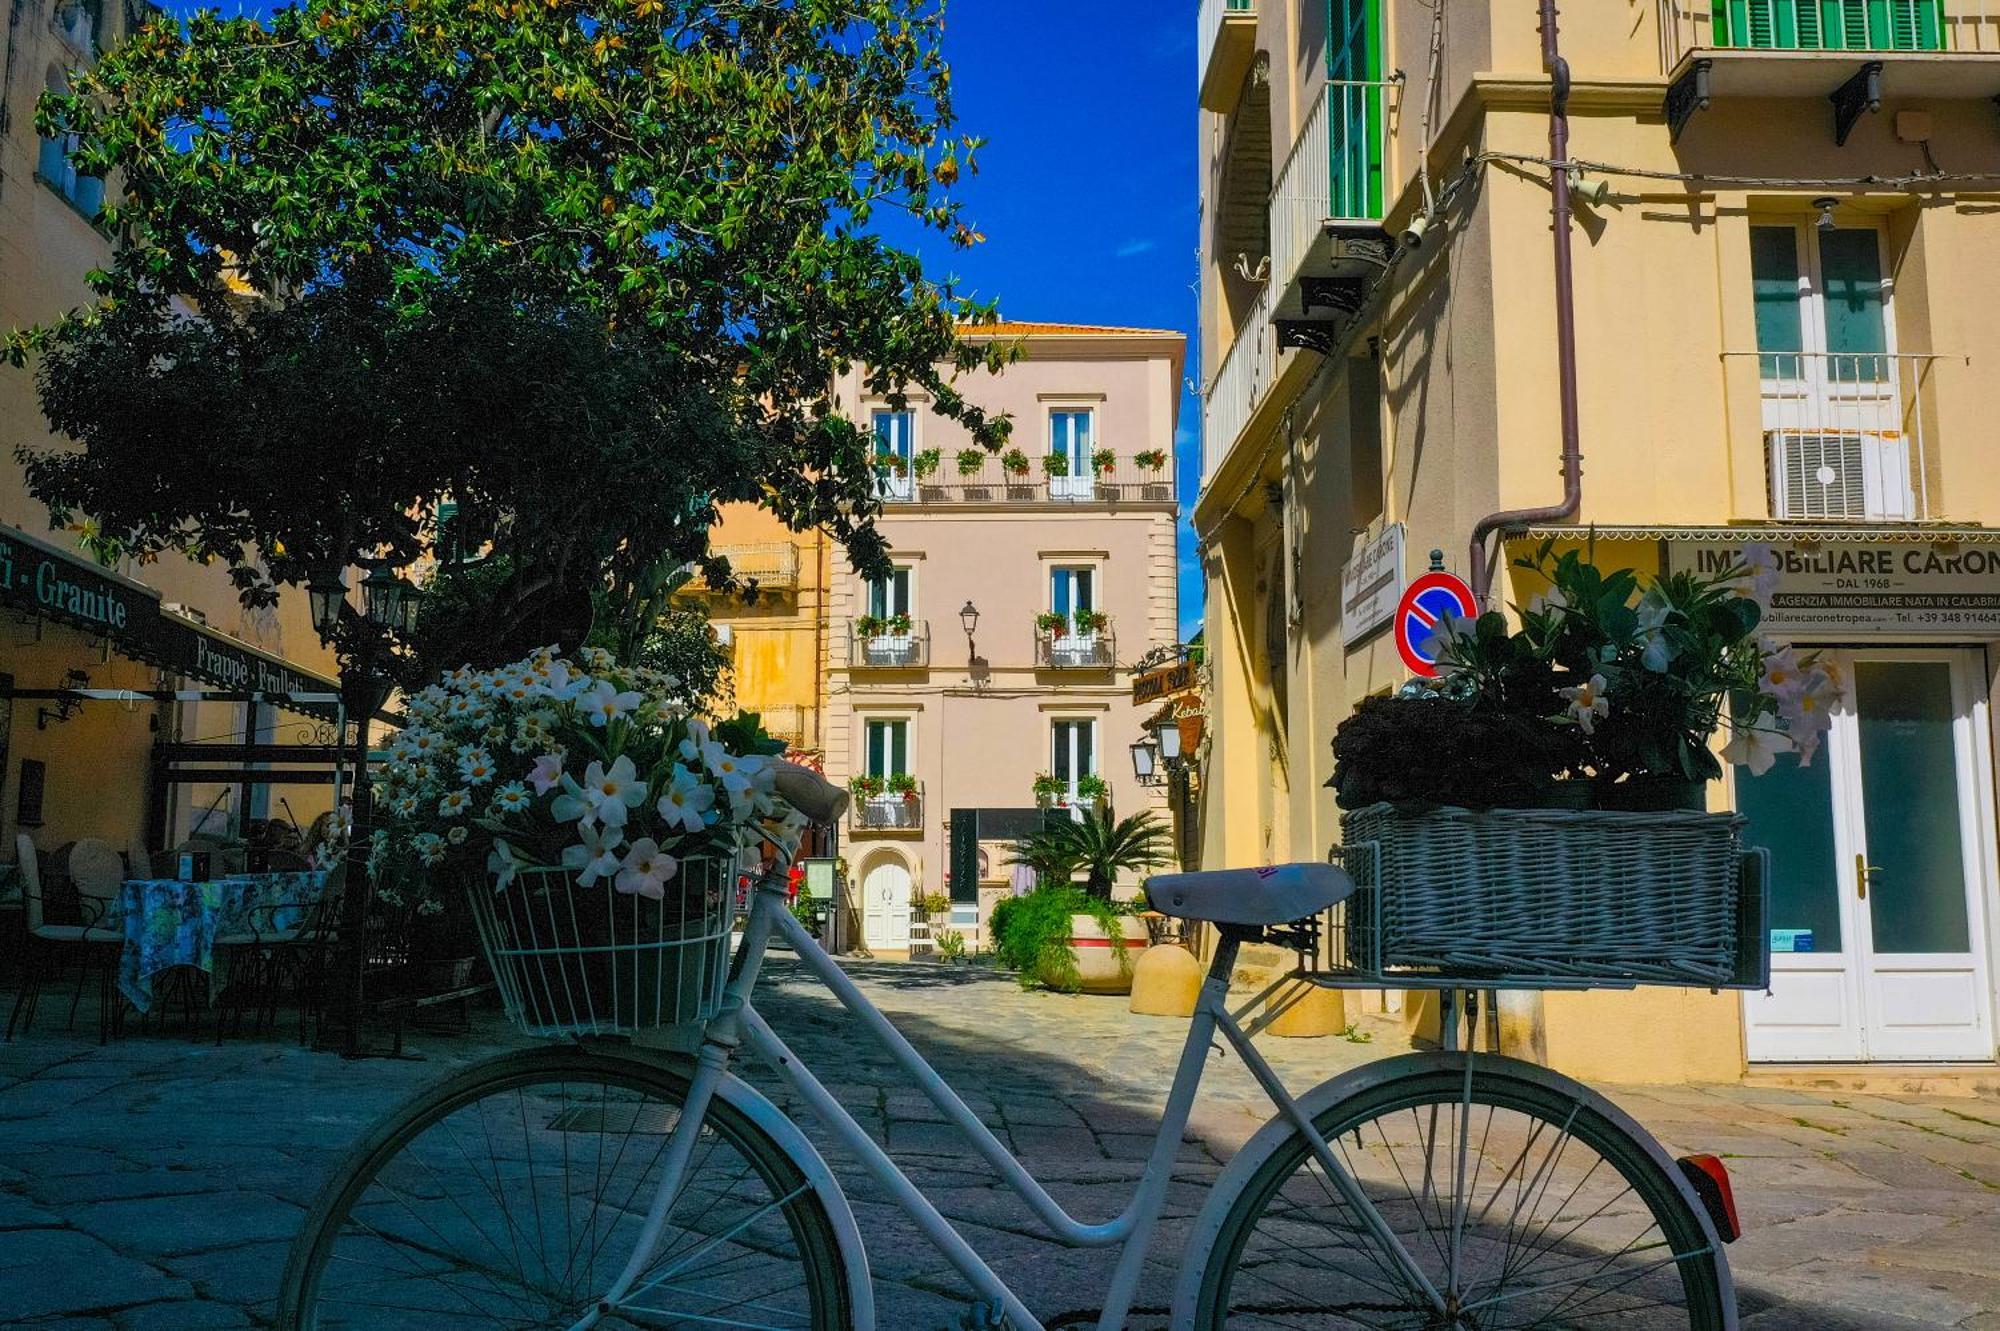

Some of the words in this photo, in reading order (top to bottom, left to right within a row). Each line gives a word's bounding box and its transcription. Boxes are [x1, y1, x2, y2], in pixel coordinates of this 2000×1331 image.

[1697, 550, 1894, 574] IMOBILIARE
[1837, 579, 1859, 588] DAL
[1864, 579, 1890, 588] 1968
[36, 561, 126, 629] Granite
[1778, 596, 1828, 606] AGENZIA
[1830, 596, 1902, 606] IMMOBILIARE
[1905, 596, 1934, 606] NATA
[1937, 596, 1949, 606] IN
[1918, 613, 1938, 622] +39
[1942, 613, 1961, 622] 348
[196, 635, 248, 685] Frappè
